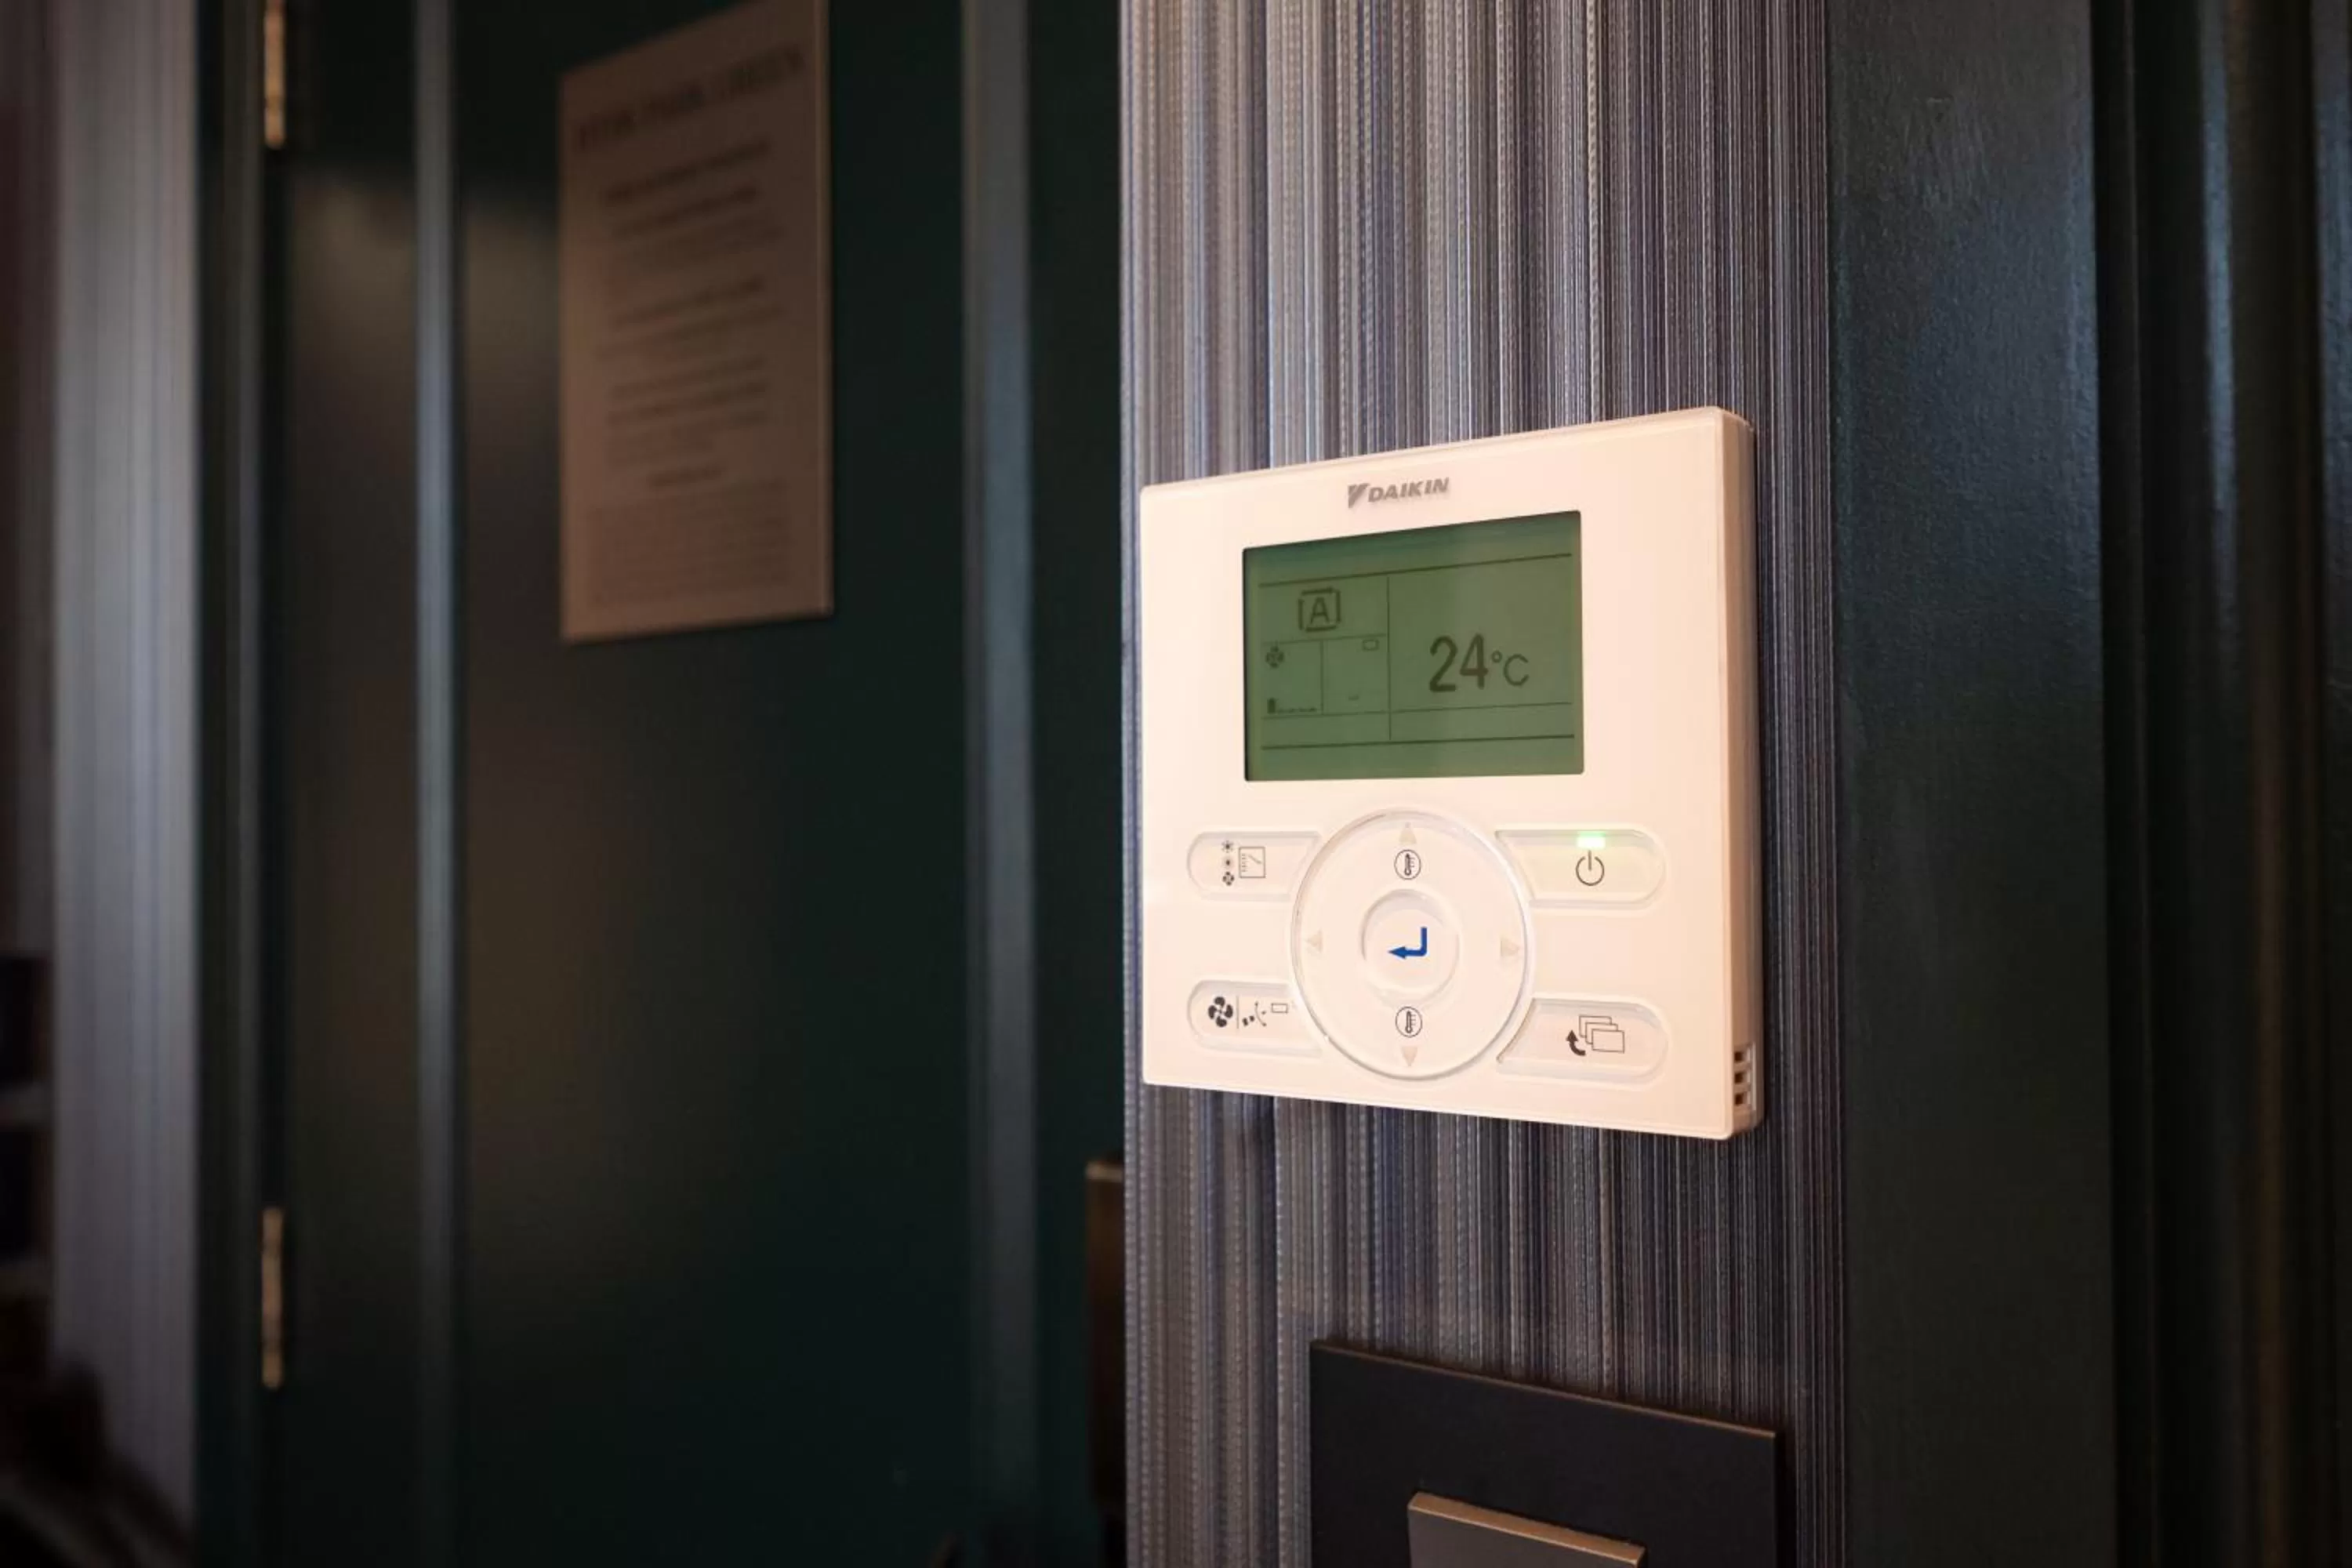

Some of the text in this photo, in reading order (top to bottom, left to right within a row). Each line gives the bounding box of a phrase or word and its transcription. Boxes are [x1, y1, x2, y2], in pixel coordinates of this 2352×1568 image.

[1368, 477, 1450, 503] DAIKIN
[1309, 597, 1330, 624] A
[1429, 633, 1530, 692] 24°C
